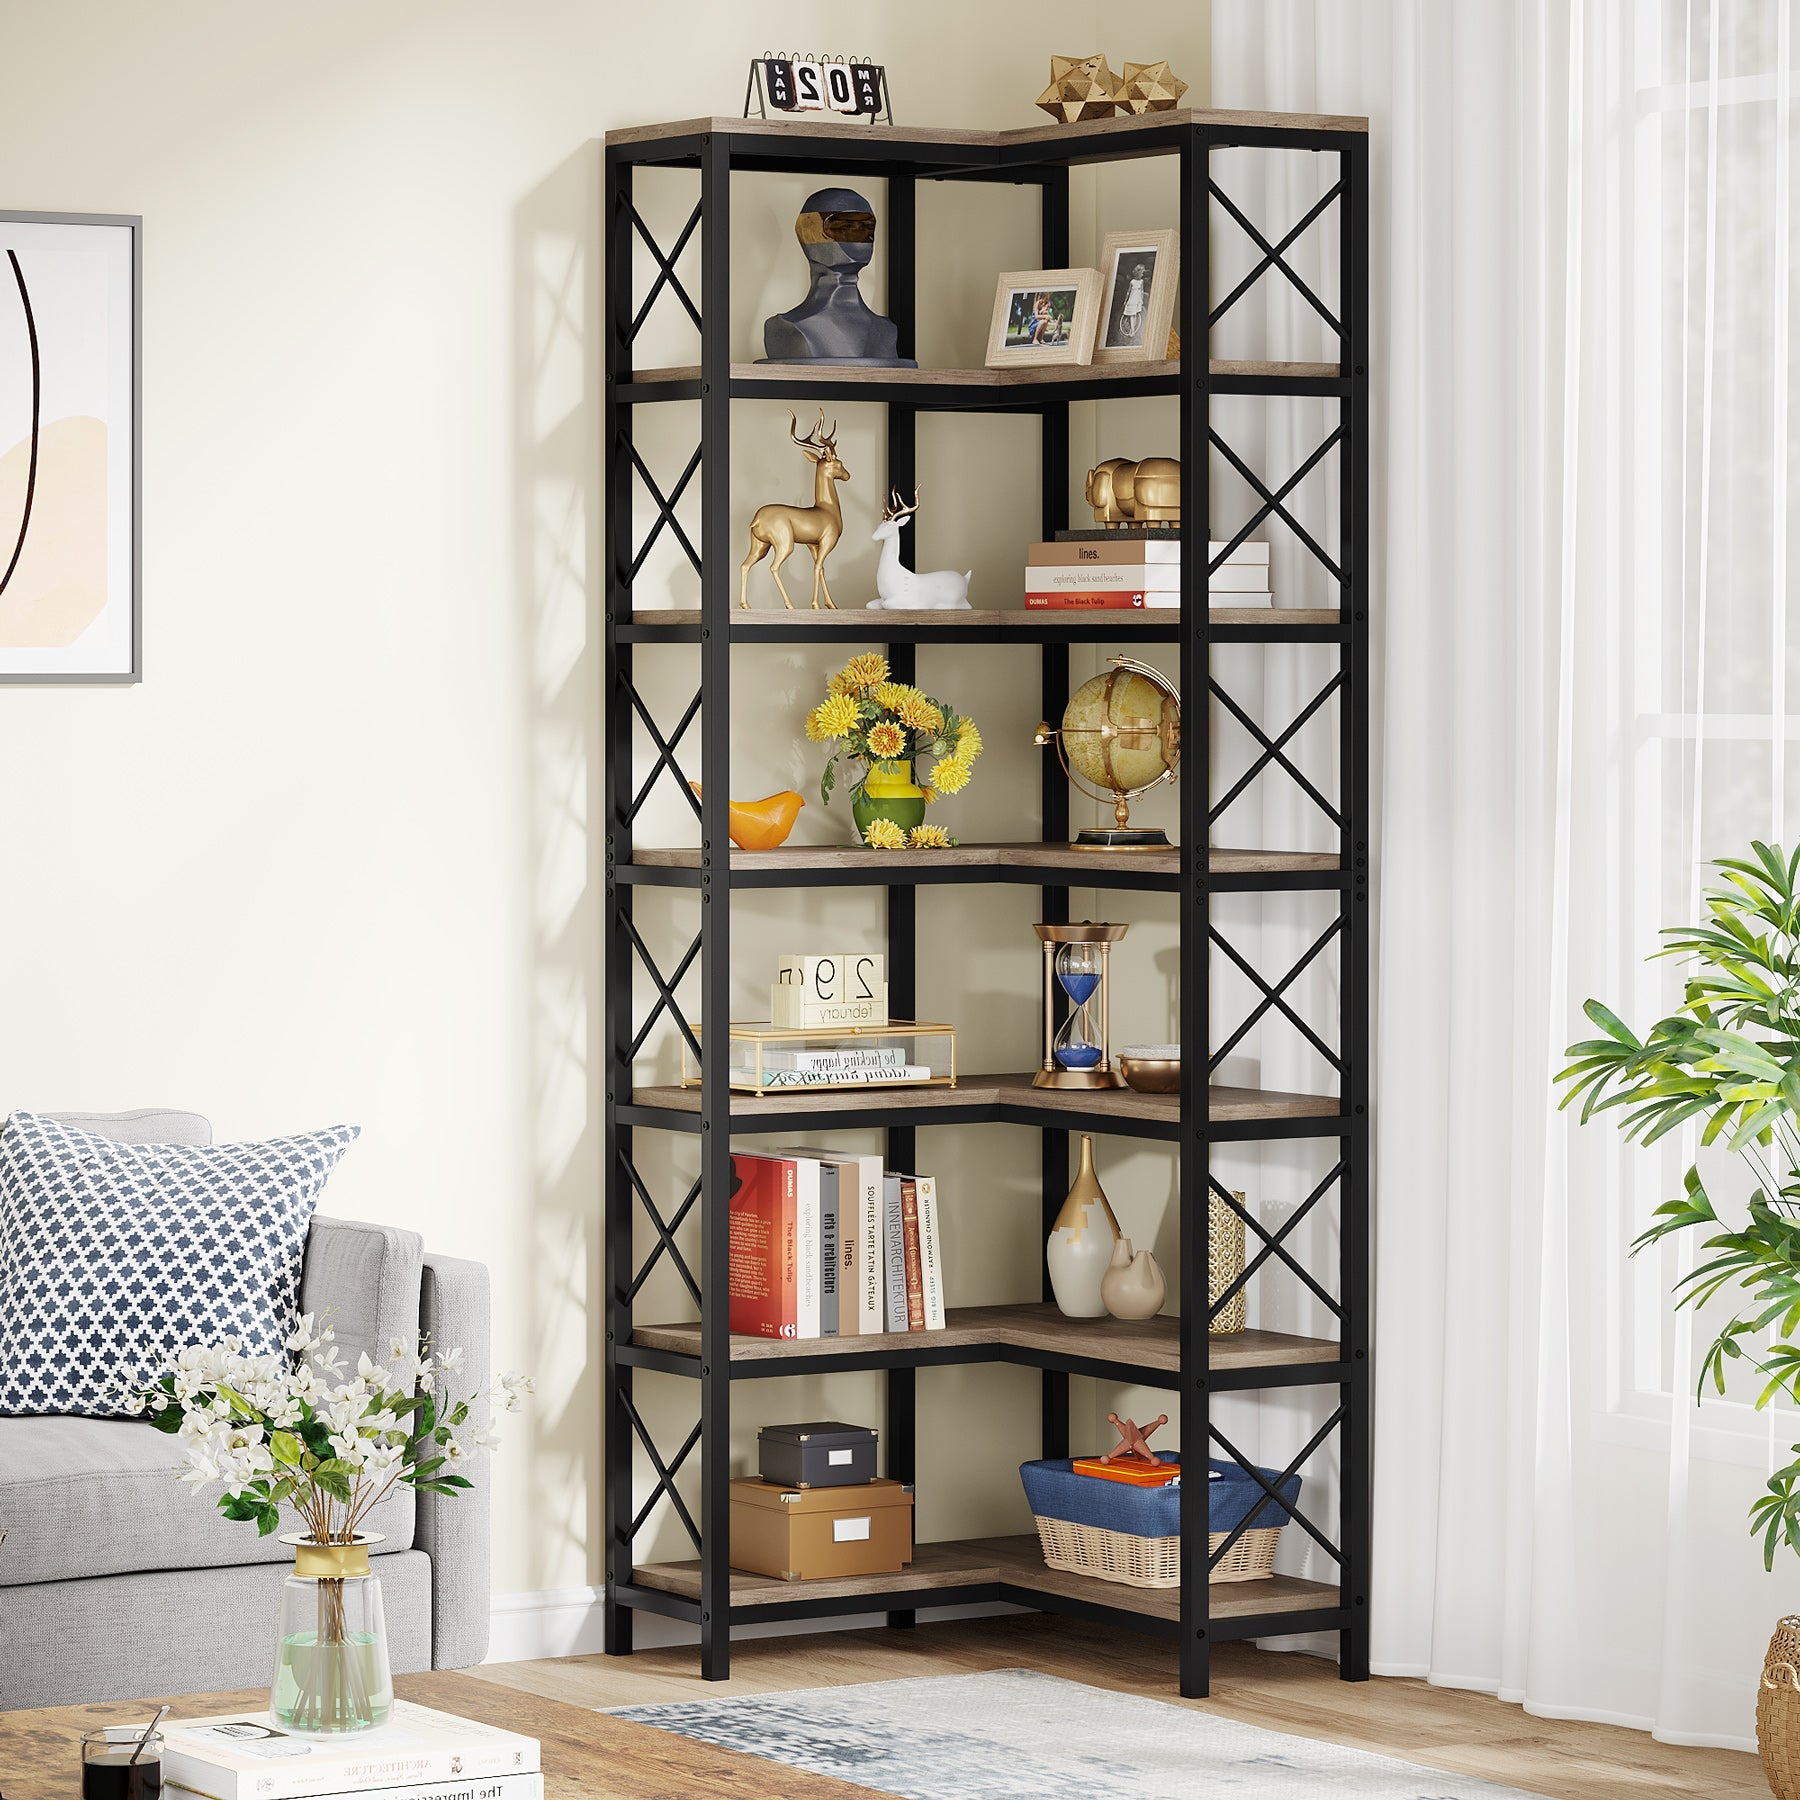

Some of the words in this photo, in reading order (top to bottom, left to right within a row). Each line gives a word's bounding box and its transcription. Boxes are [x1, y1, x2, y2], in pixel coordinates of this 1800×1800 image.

[1078, 547, 1100, 560] lines.
[1053, 574, 1077, 586] exploring
[1077, 573, 1091, 583] black
[1029, 598, 1048, 606] DUMAS
[1090, 598, 1105, 606] Tulip
[803, 1203, 813, 1238] exploring
[824, 1213, 835, 1230] arts
[924, 1199, 932, 1233] CHANDLER
[867, 1225, 875, 1248] TARTE
[805, 1239, 813, 1259] black
[844, 1240, 854, 1270] lines.
[926, 1234, 934, 1268] RAYMOND
[824, 1243, 835, 1294] architecture
[867, 1250, 875, 1273] TATIN
[888, 1201, 906, 1323] INNENARCHITEKTUR
